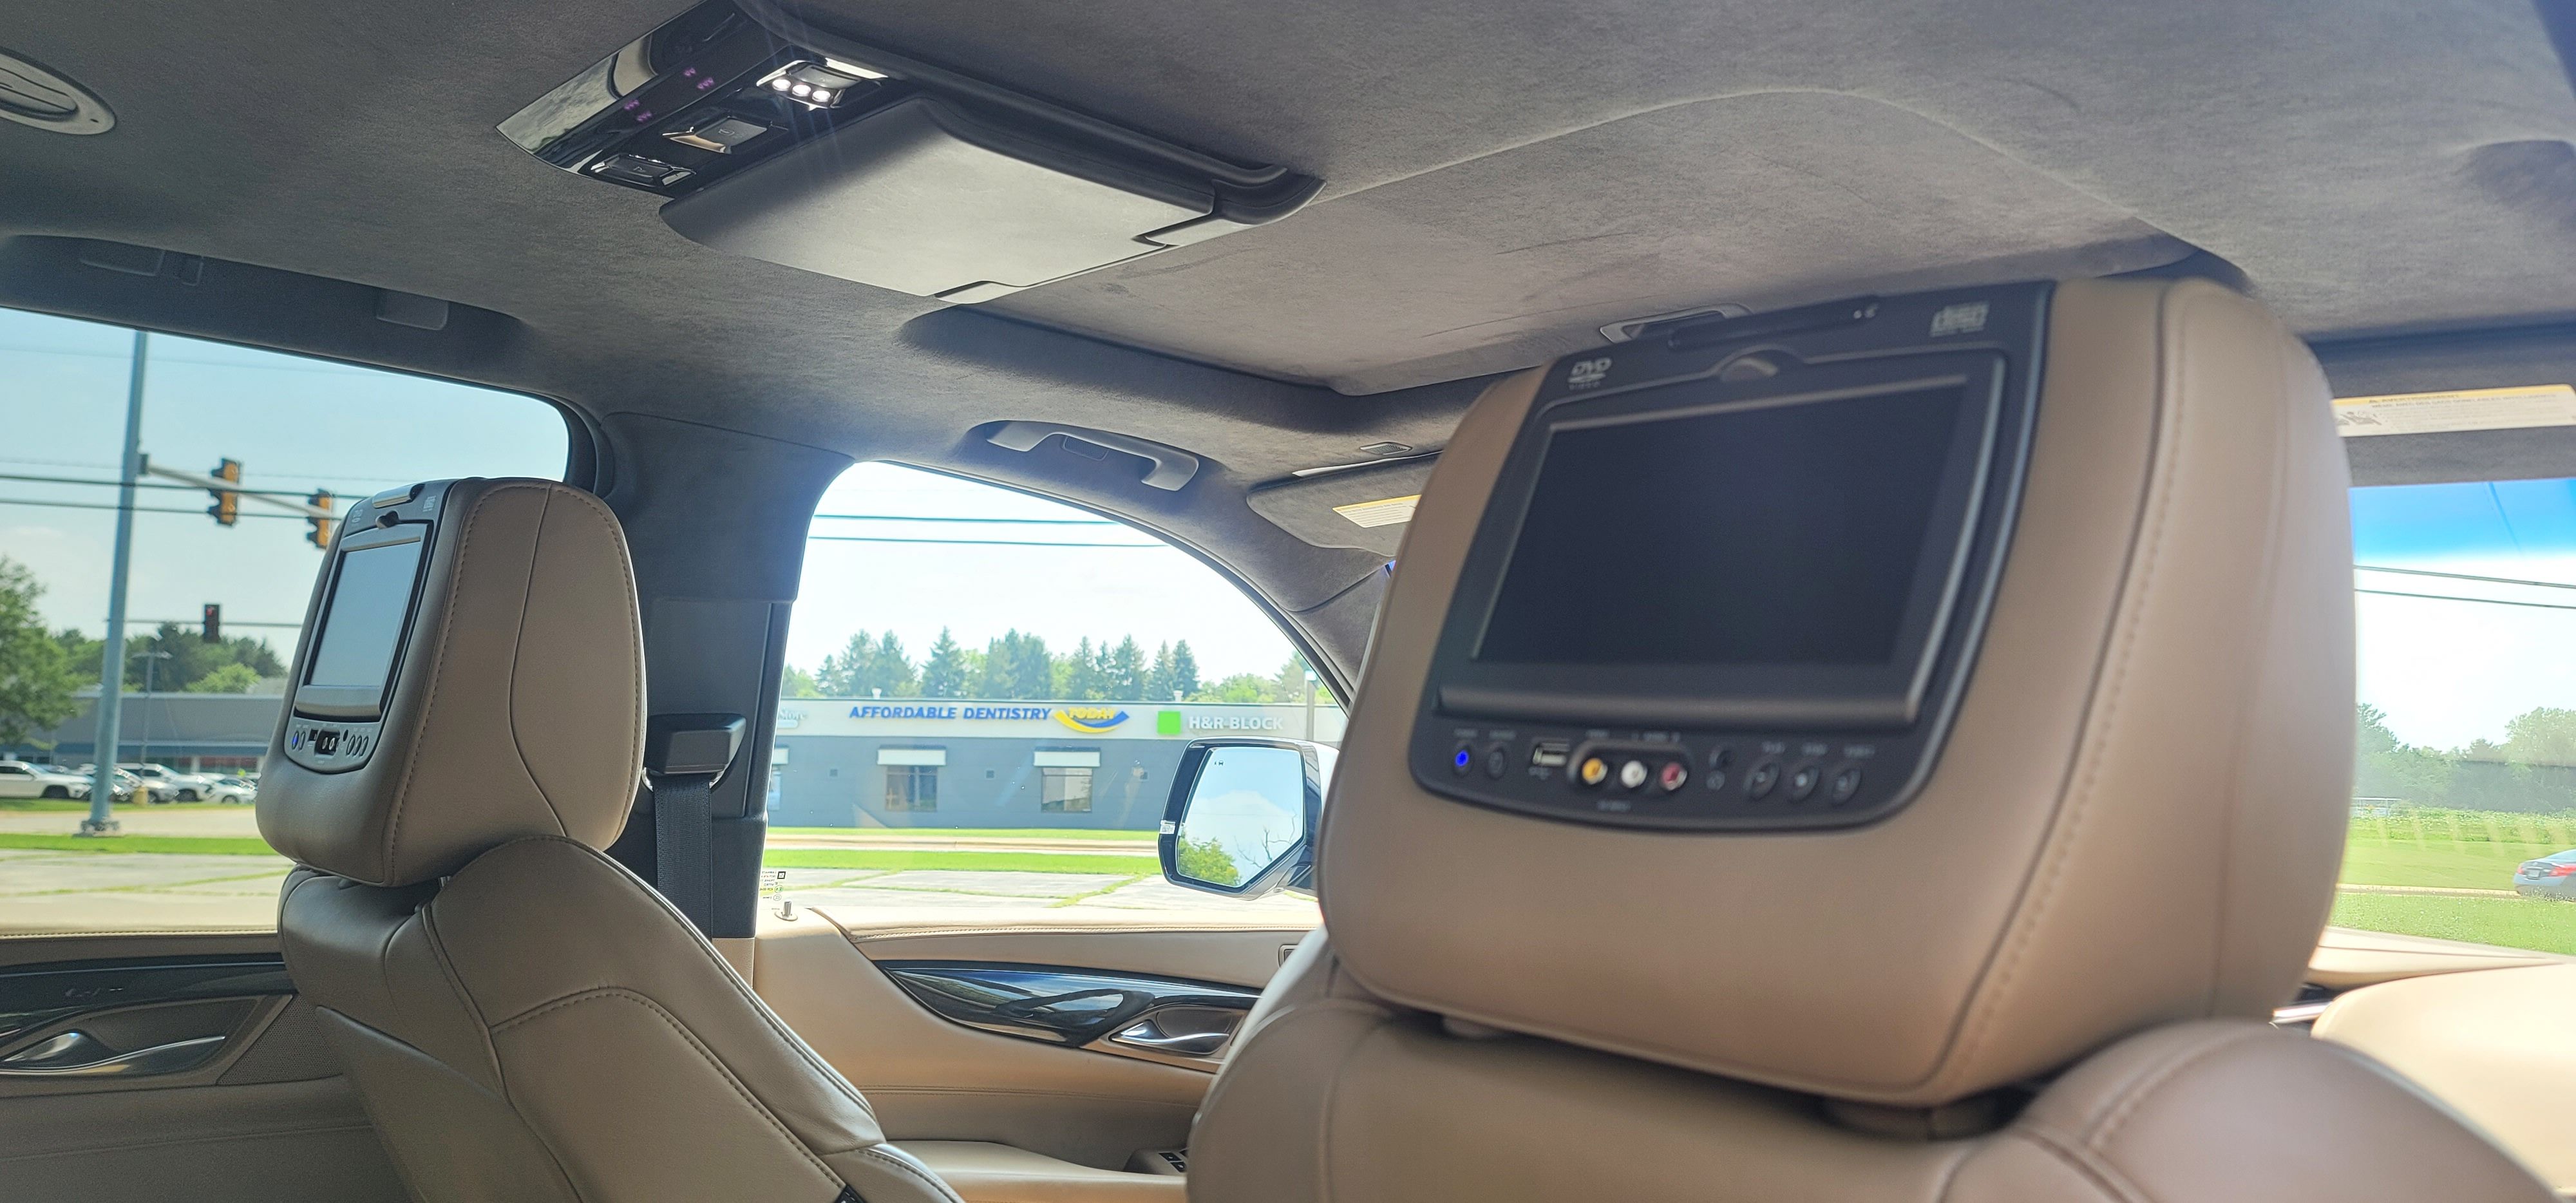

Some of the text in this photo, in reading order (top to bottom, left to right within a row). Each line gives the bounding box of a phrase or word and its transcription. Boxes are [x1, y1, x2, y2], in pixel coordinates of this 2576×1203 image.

[849, 706, 1053, 720] AFFORDABLE DENTISTRY
[1068, 706, 1115, 719] TODAY
[1229, 717, 1283, 730] BLOCK
